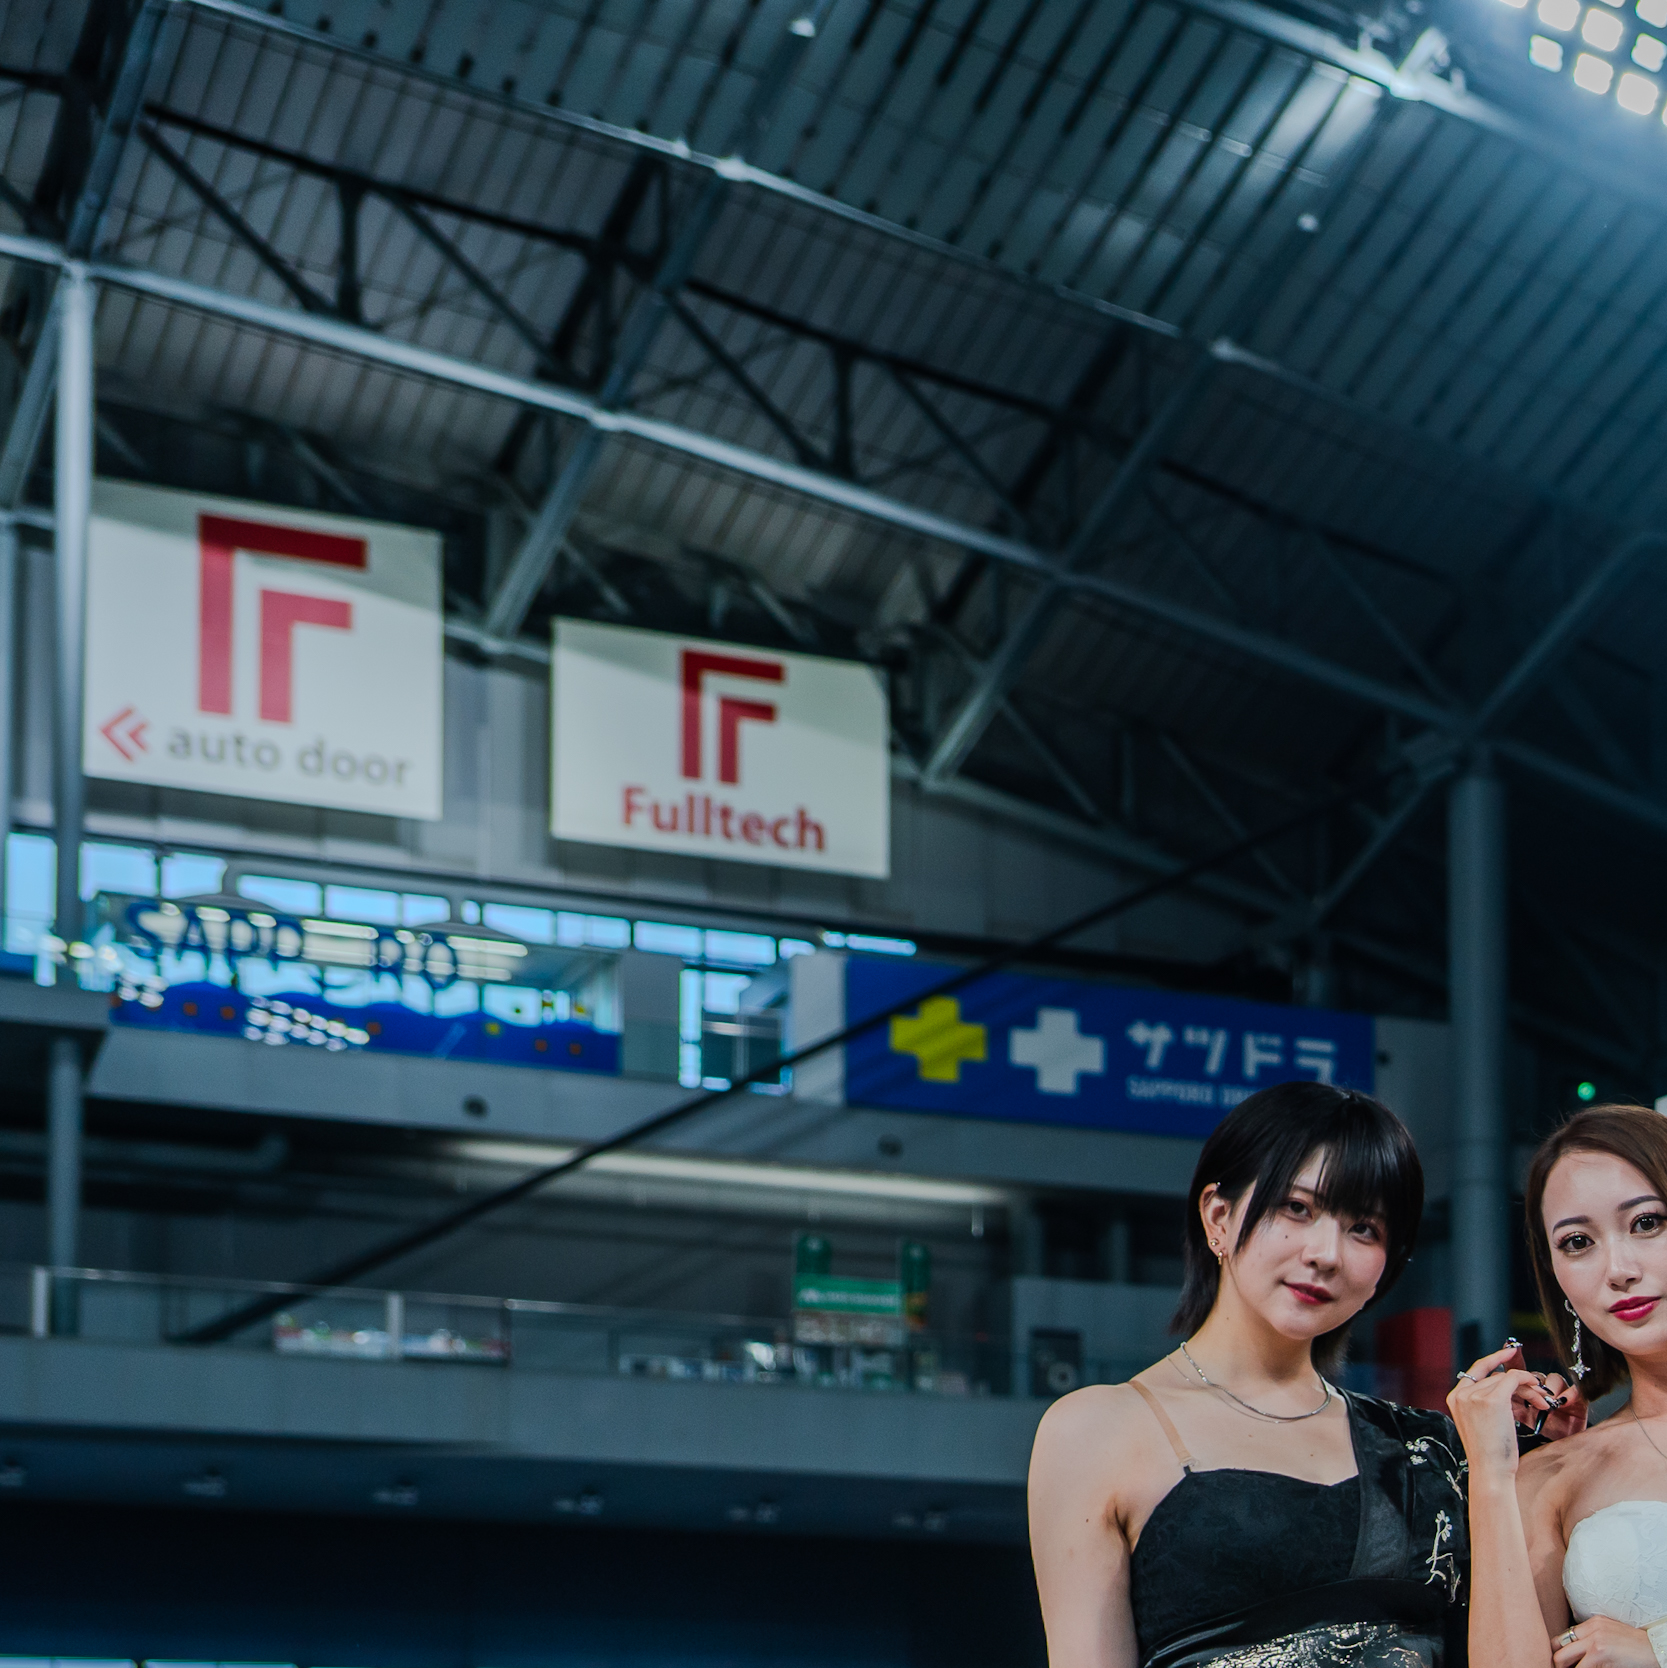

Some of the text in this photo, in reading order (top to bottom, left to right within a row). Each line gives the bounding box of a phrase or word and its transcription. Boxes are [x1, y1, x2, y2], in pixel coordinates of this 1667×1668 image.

[167, 721, 411, 789] auto door
[621, 784, 827, 855] Fulltech
[1125, 1018, 1338, 1085] サツドラ
